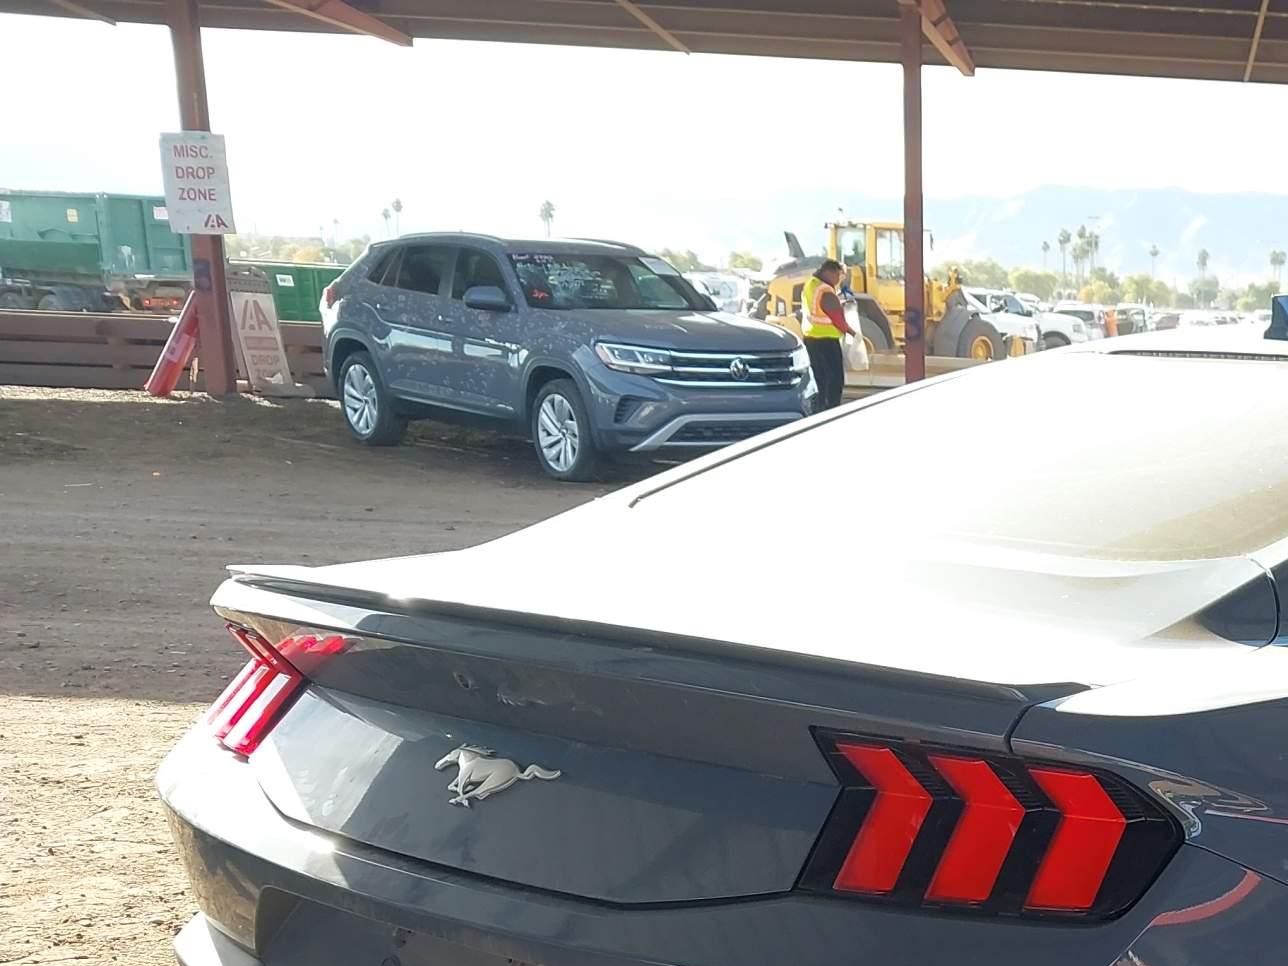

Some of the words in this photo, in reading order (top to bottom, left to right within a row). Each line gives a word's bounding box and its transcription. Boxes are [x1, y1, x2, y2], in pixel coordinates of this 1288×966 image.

[173, 144, 213, 159] MISC.
[175, 166, 215, 180] DROP
[178, 187, 217, 201] ZONE
